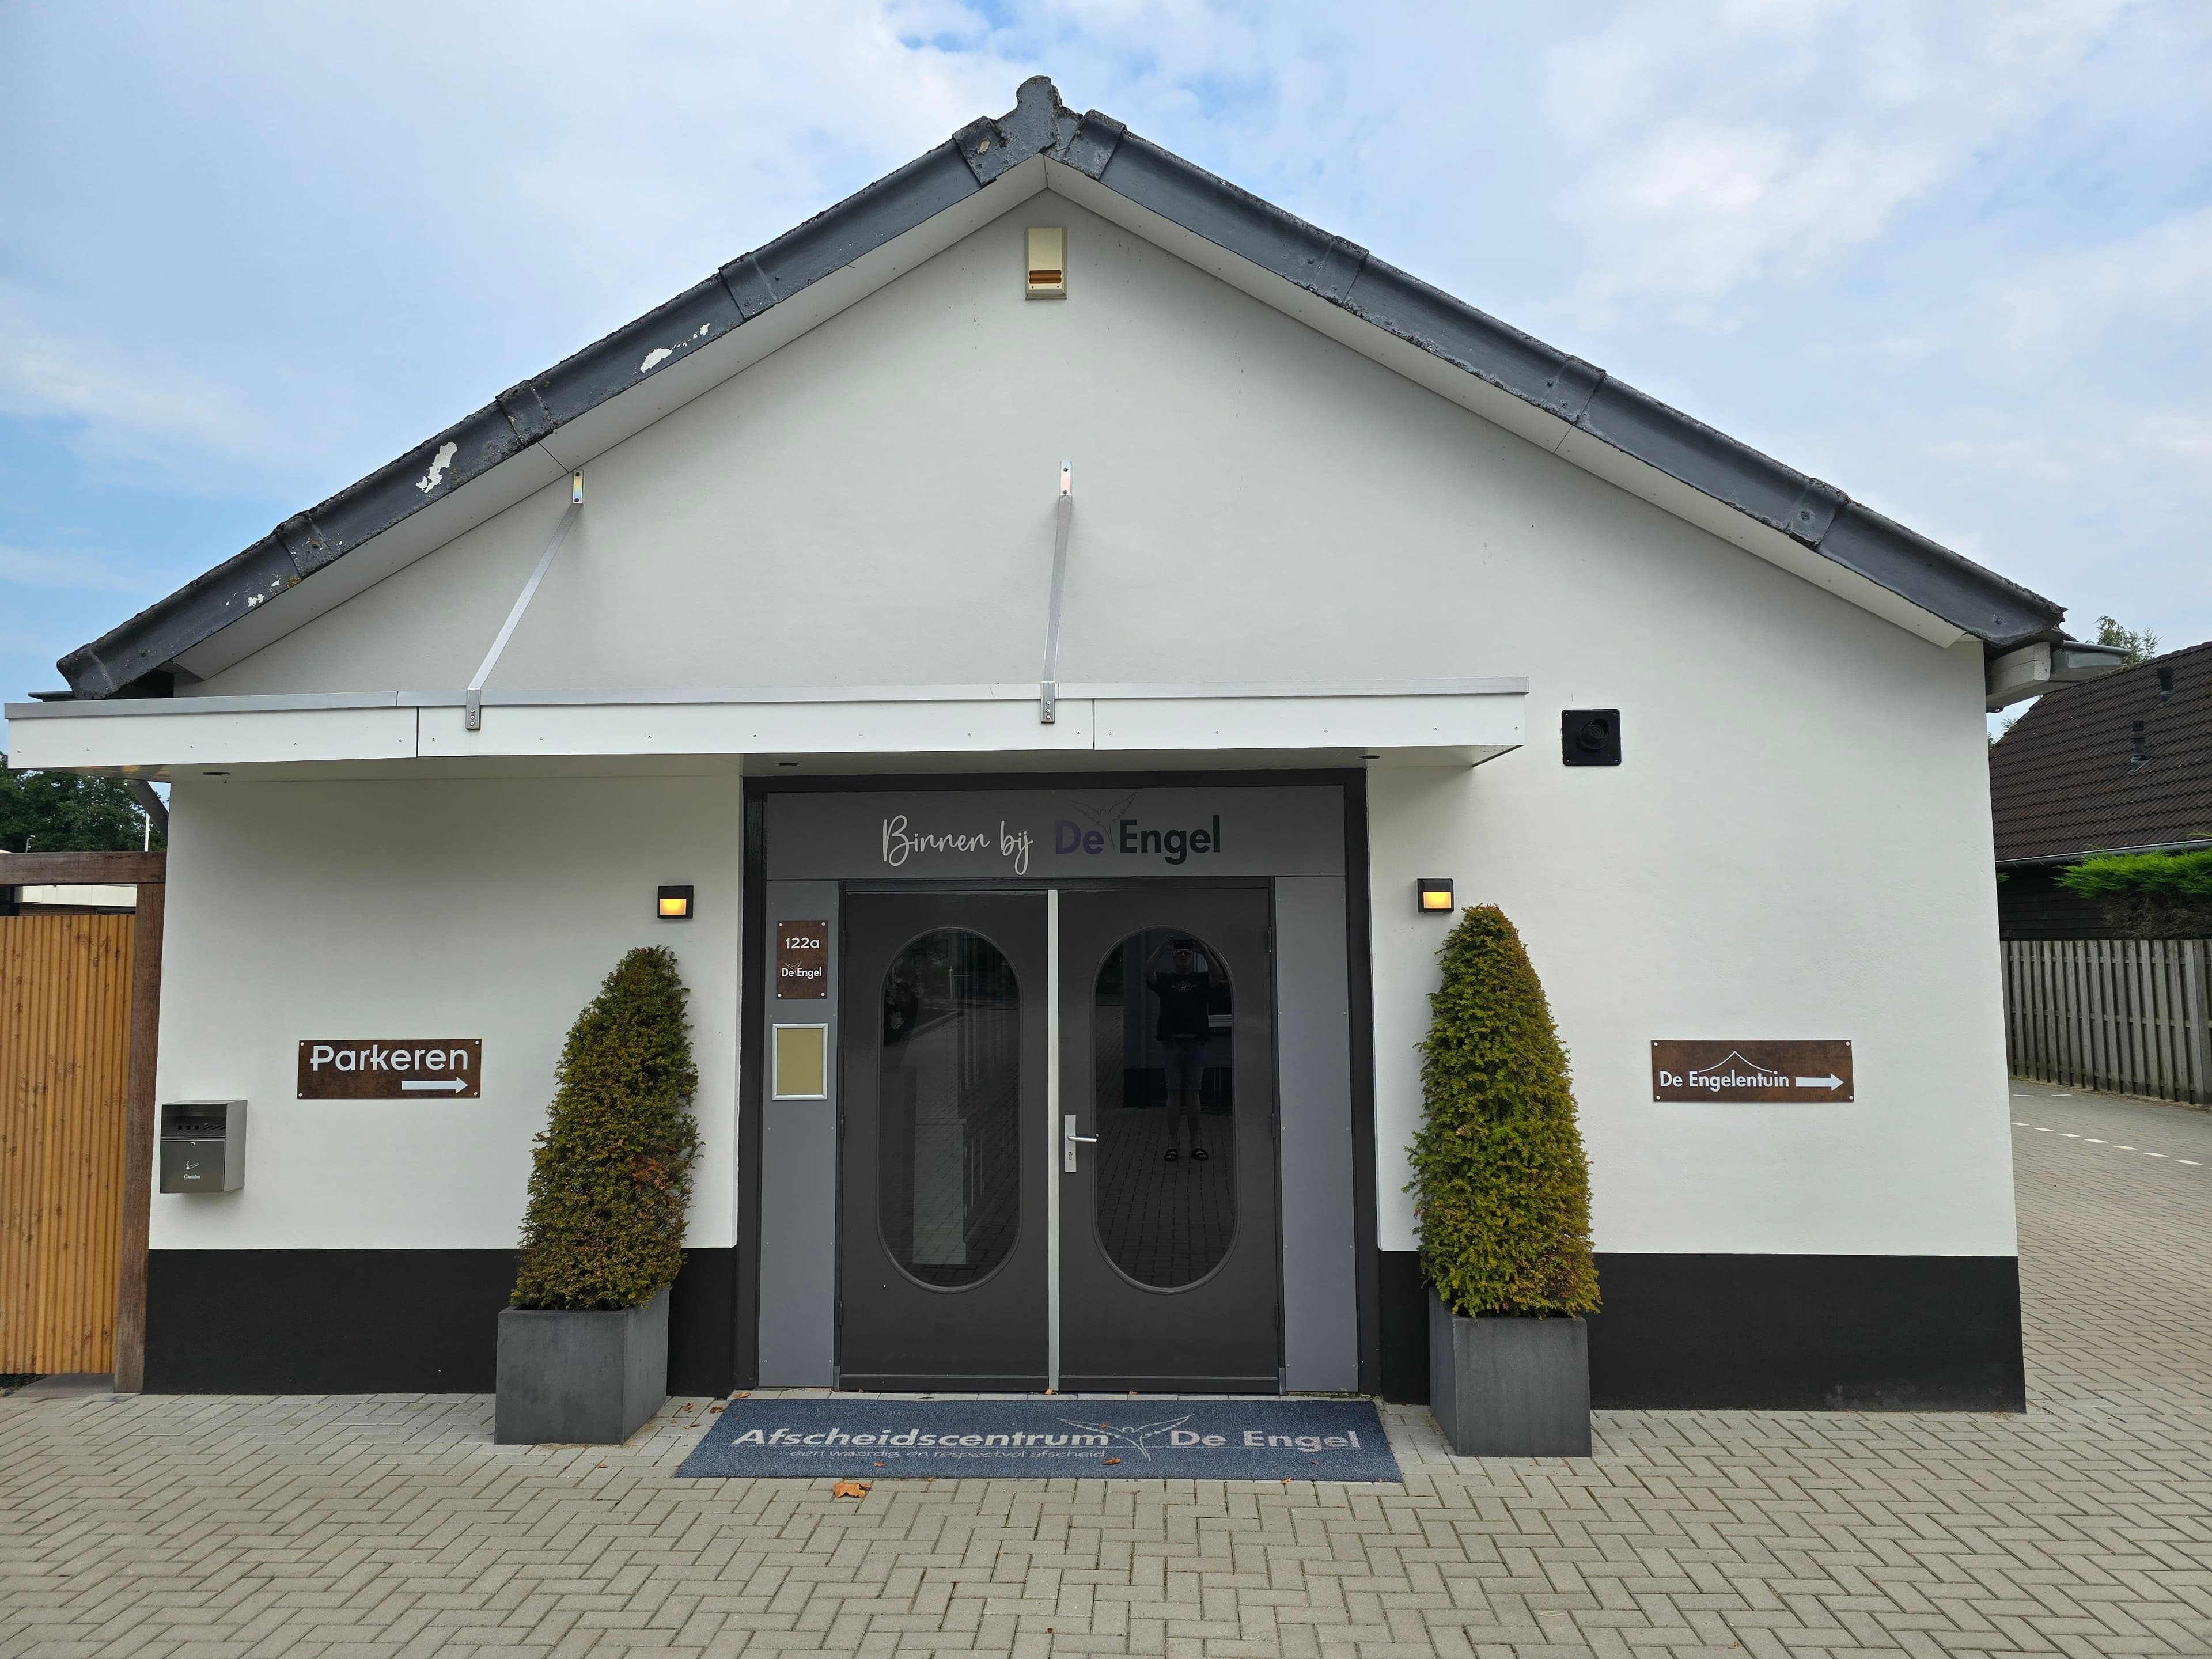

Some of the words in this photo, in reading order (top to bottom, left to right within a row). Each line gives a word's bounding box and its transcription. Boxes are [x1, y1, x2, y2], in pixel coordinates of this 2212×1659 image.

[883, 815, 990, 866] Binnen
[999, 820, 1033, 875] bij
[1055, 819, 1104, 855] De
[1119, 815, 1221, 865] Engel
[785, 937, 820, 949] 122a
[781, 968, 794, 977] De
[797, 967, 822, 979] Engel
[310, 1044, 468, 1071] Parkeren
[1660, 1070, 1683, 1088] De
[1689, 1069, 1789, 1092] Engelentuin
[730, 1428, 1109, 1446] Afscheidscentrum
[1171, 1430, 1226, 1446] De
[1243, 1430, 1361, 1452] Engel
[830, 1449, 900, 1459] waardig
[934, 1450, 1025, 1459] respectvol
[1030, 1449, 1105, 1459] afscheid
